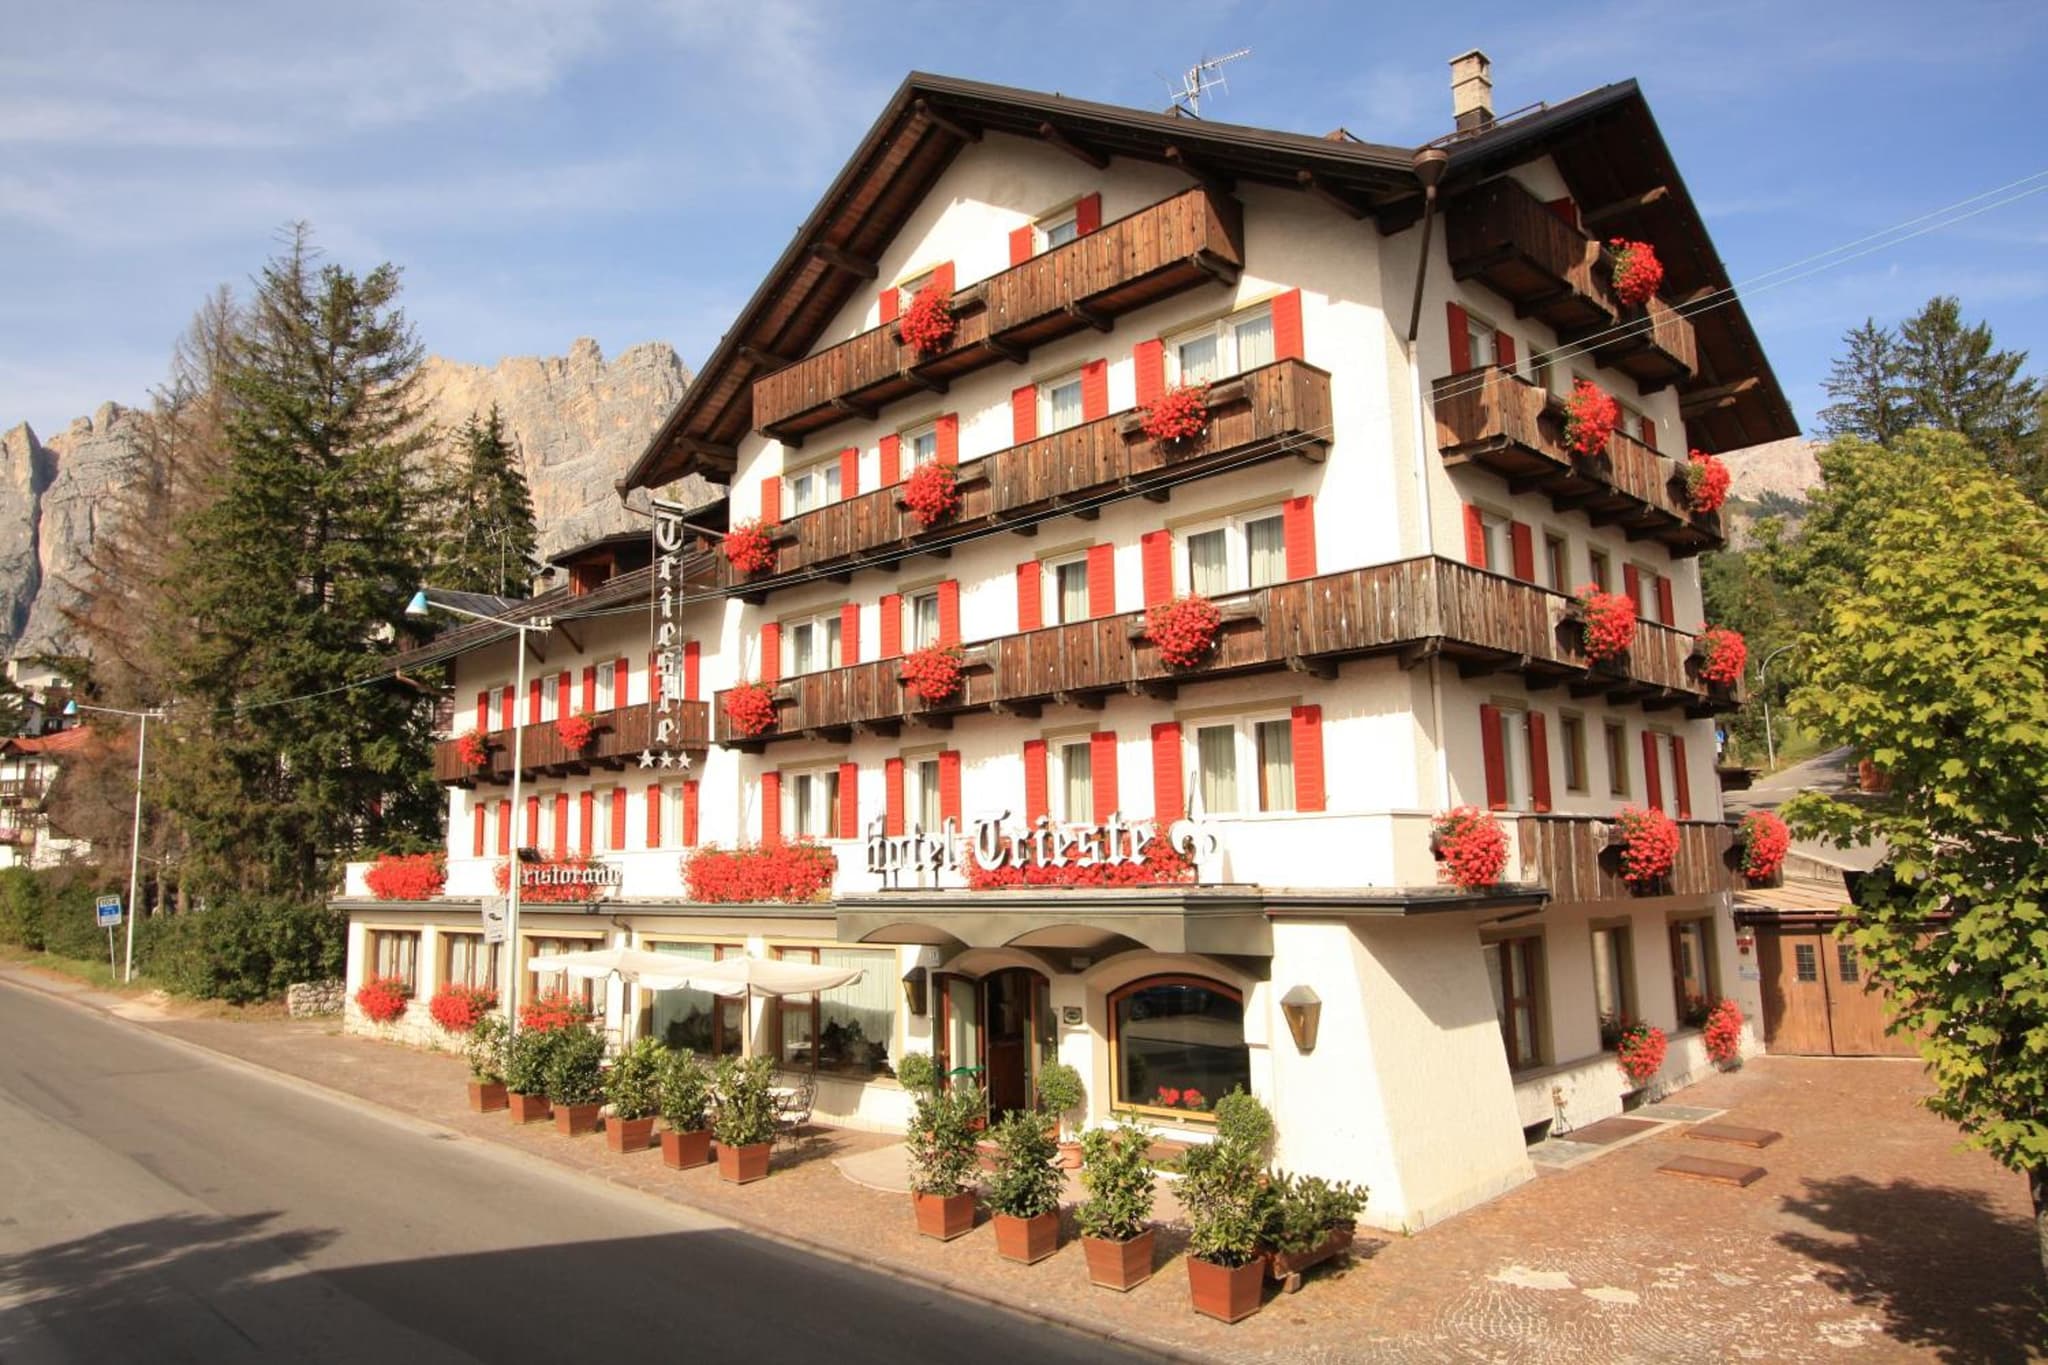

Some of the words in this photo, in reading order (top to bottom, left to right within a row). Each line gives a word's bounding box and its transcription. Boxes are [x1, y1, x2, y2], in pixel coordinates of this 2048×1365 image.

[656, 513, 683, 744] Trieste
[974, 810, 1156, 871] Trieste
[522, 865, 623, 885] ristorante
